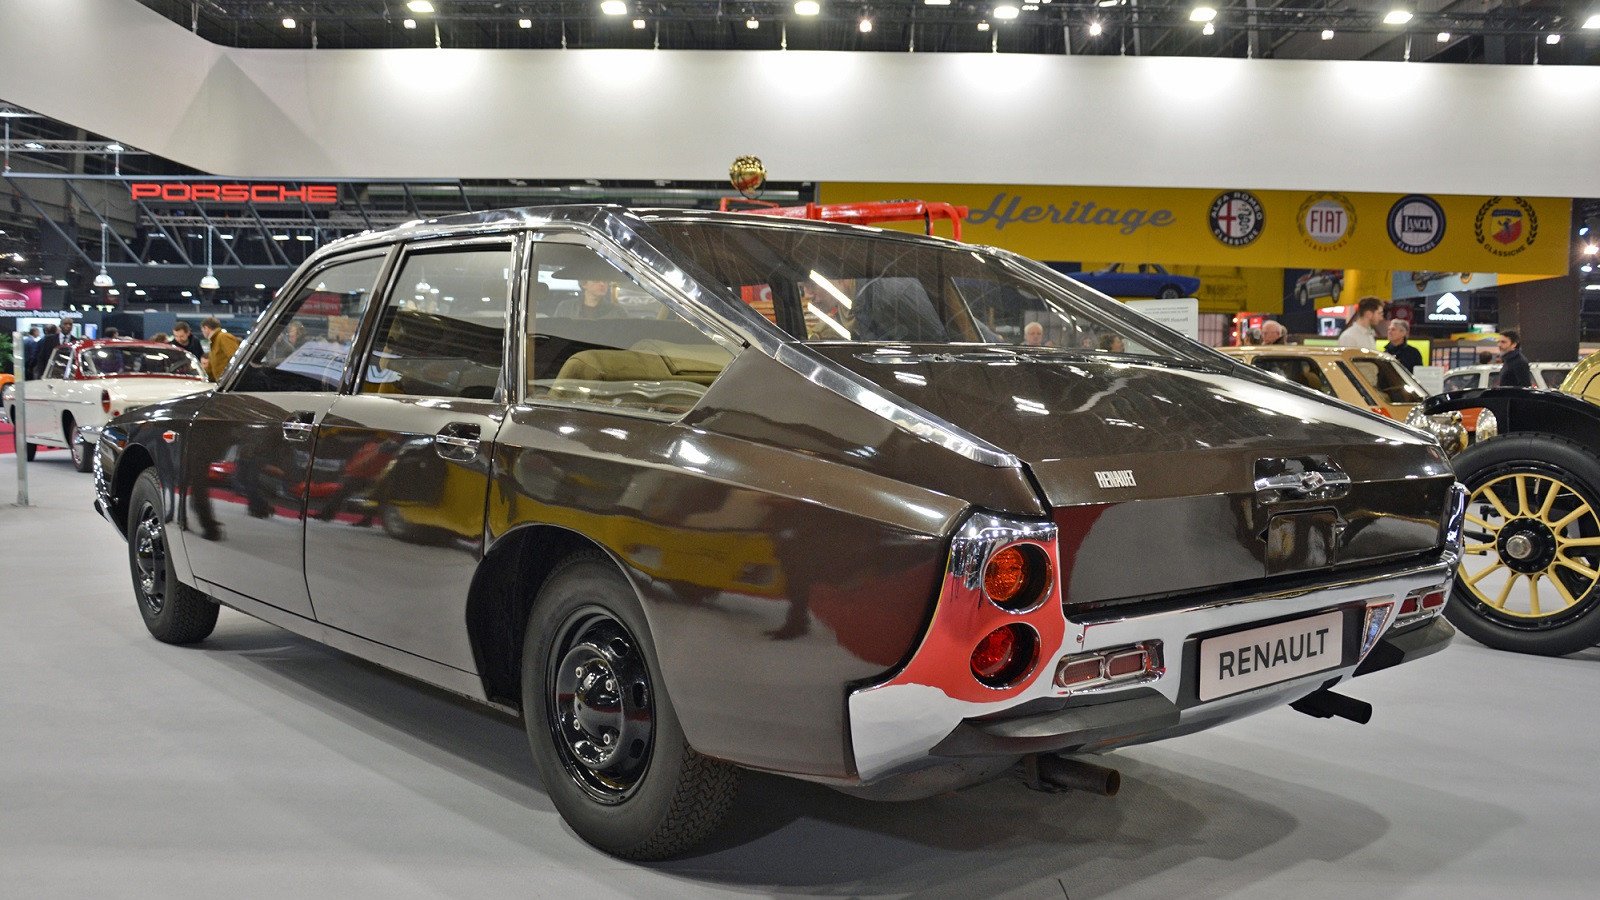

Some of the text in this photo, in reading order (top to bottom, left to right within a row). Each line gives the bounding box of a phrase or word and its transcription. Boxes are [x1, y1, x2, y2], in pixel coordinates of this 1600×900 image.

[131, 183, 338, 203] PORSCHE
[1233, 191, 1263, 221] ROMEO
[965, 192, 1176, 236] Heritage
[1310, 210, 1344, 233] FIAT
[1094, 469, 1137, 488] RENAULT
[1219, 628, 1329, 680] RENAULT
